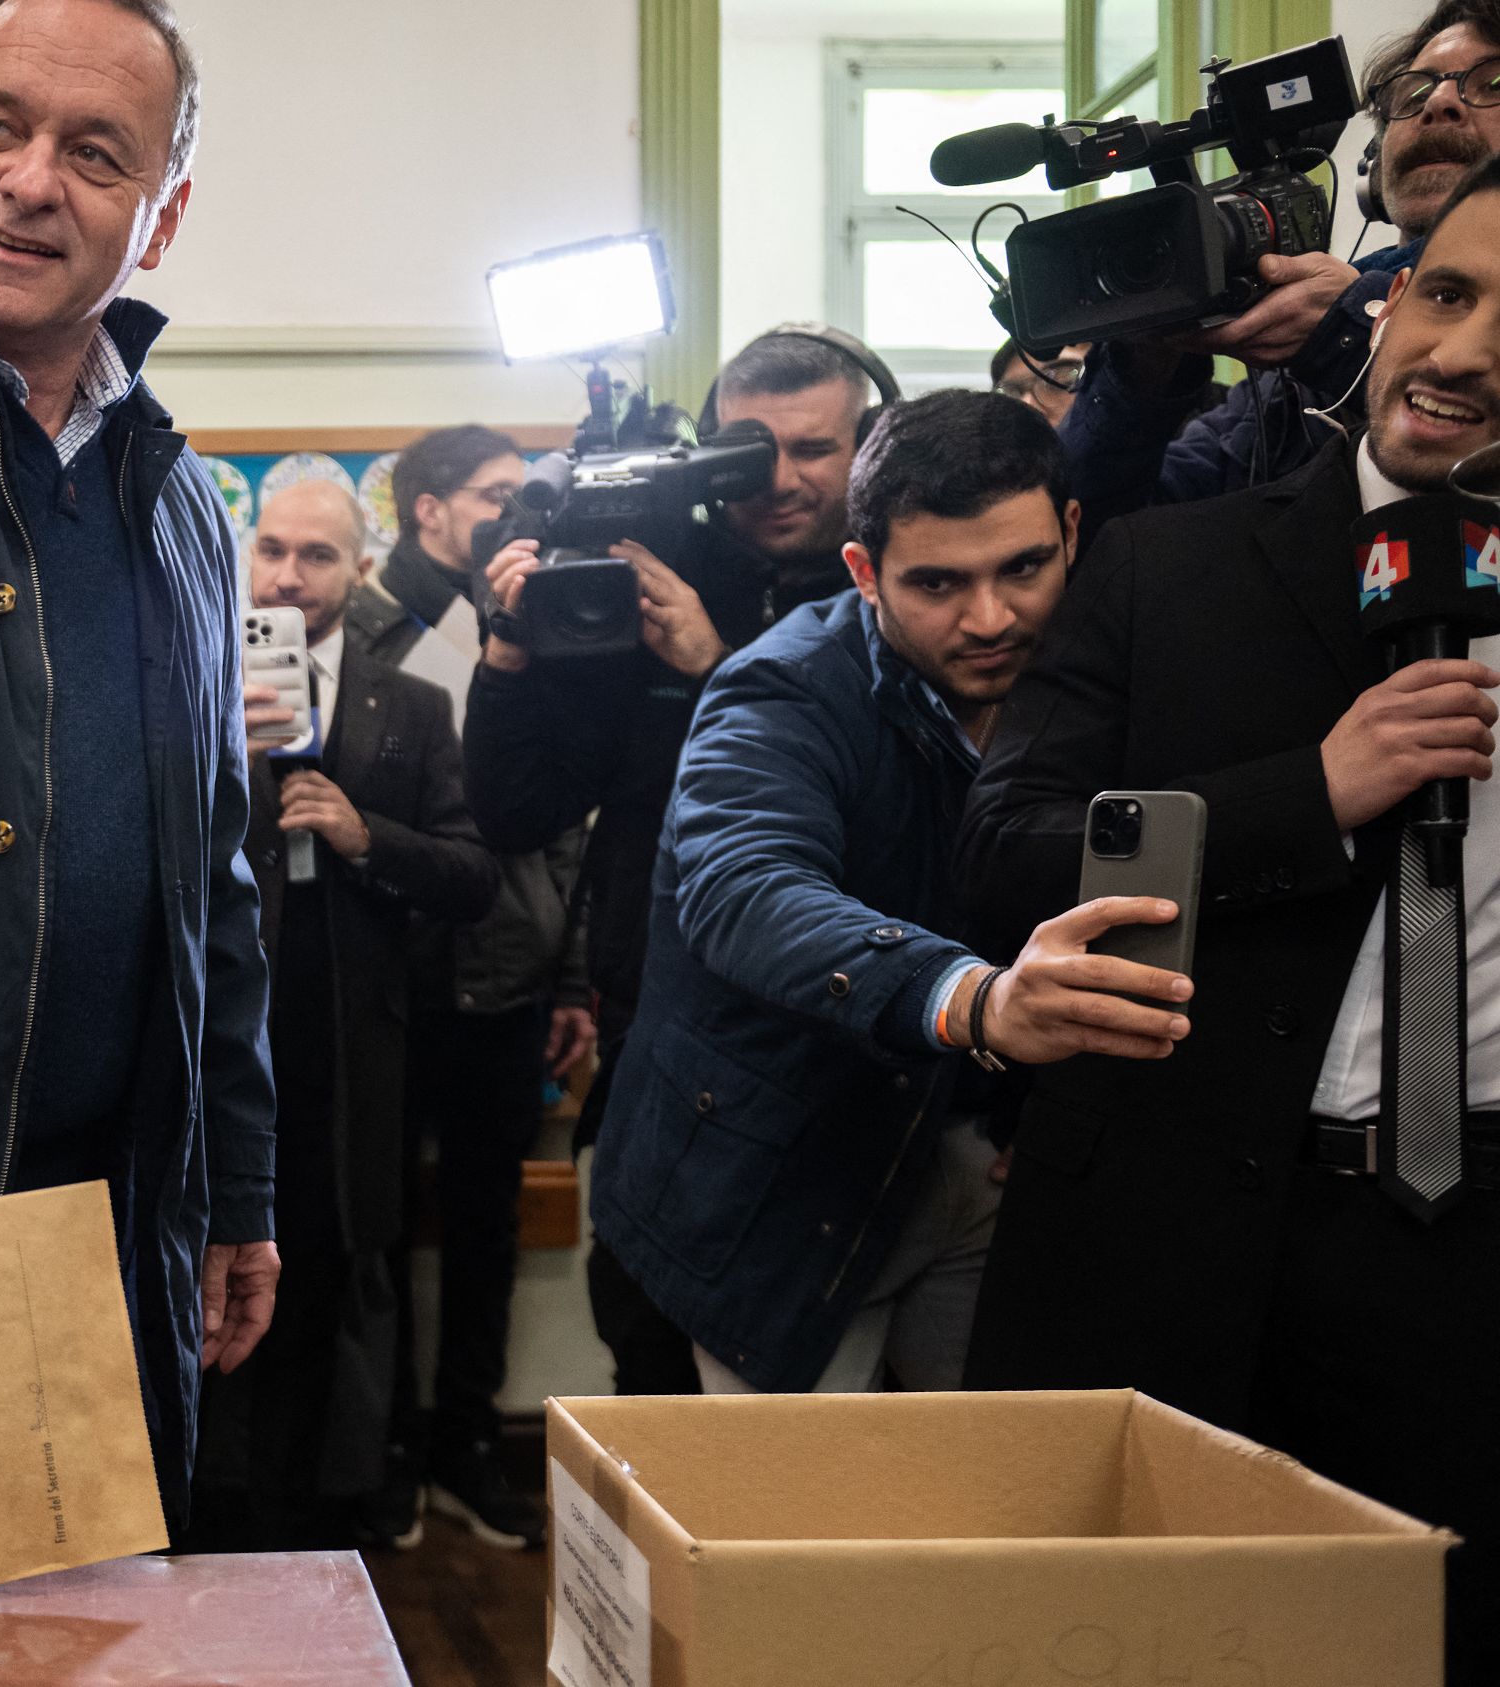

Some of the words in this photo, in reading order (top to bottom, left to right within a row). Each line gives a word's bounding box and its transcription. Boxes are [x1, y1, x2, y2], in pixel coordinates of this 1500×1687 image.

[1363, 530, 1398, 602] 4
[42, 1442, 61, 1494] Secretario
[47, 1495, 62, 1511] del
[54, 1513, 67, 1544] Firma
